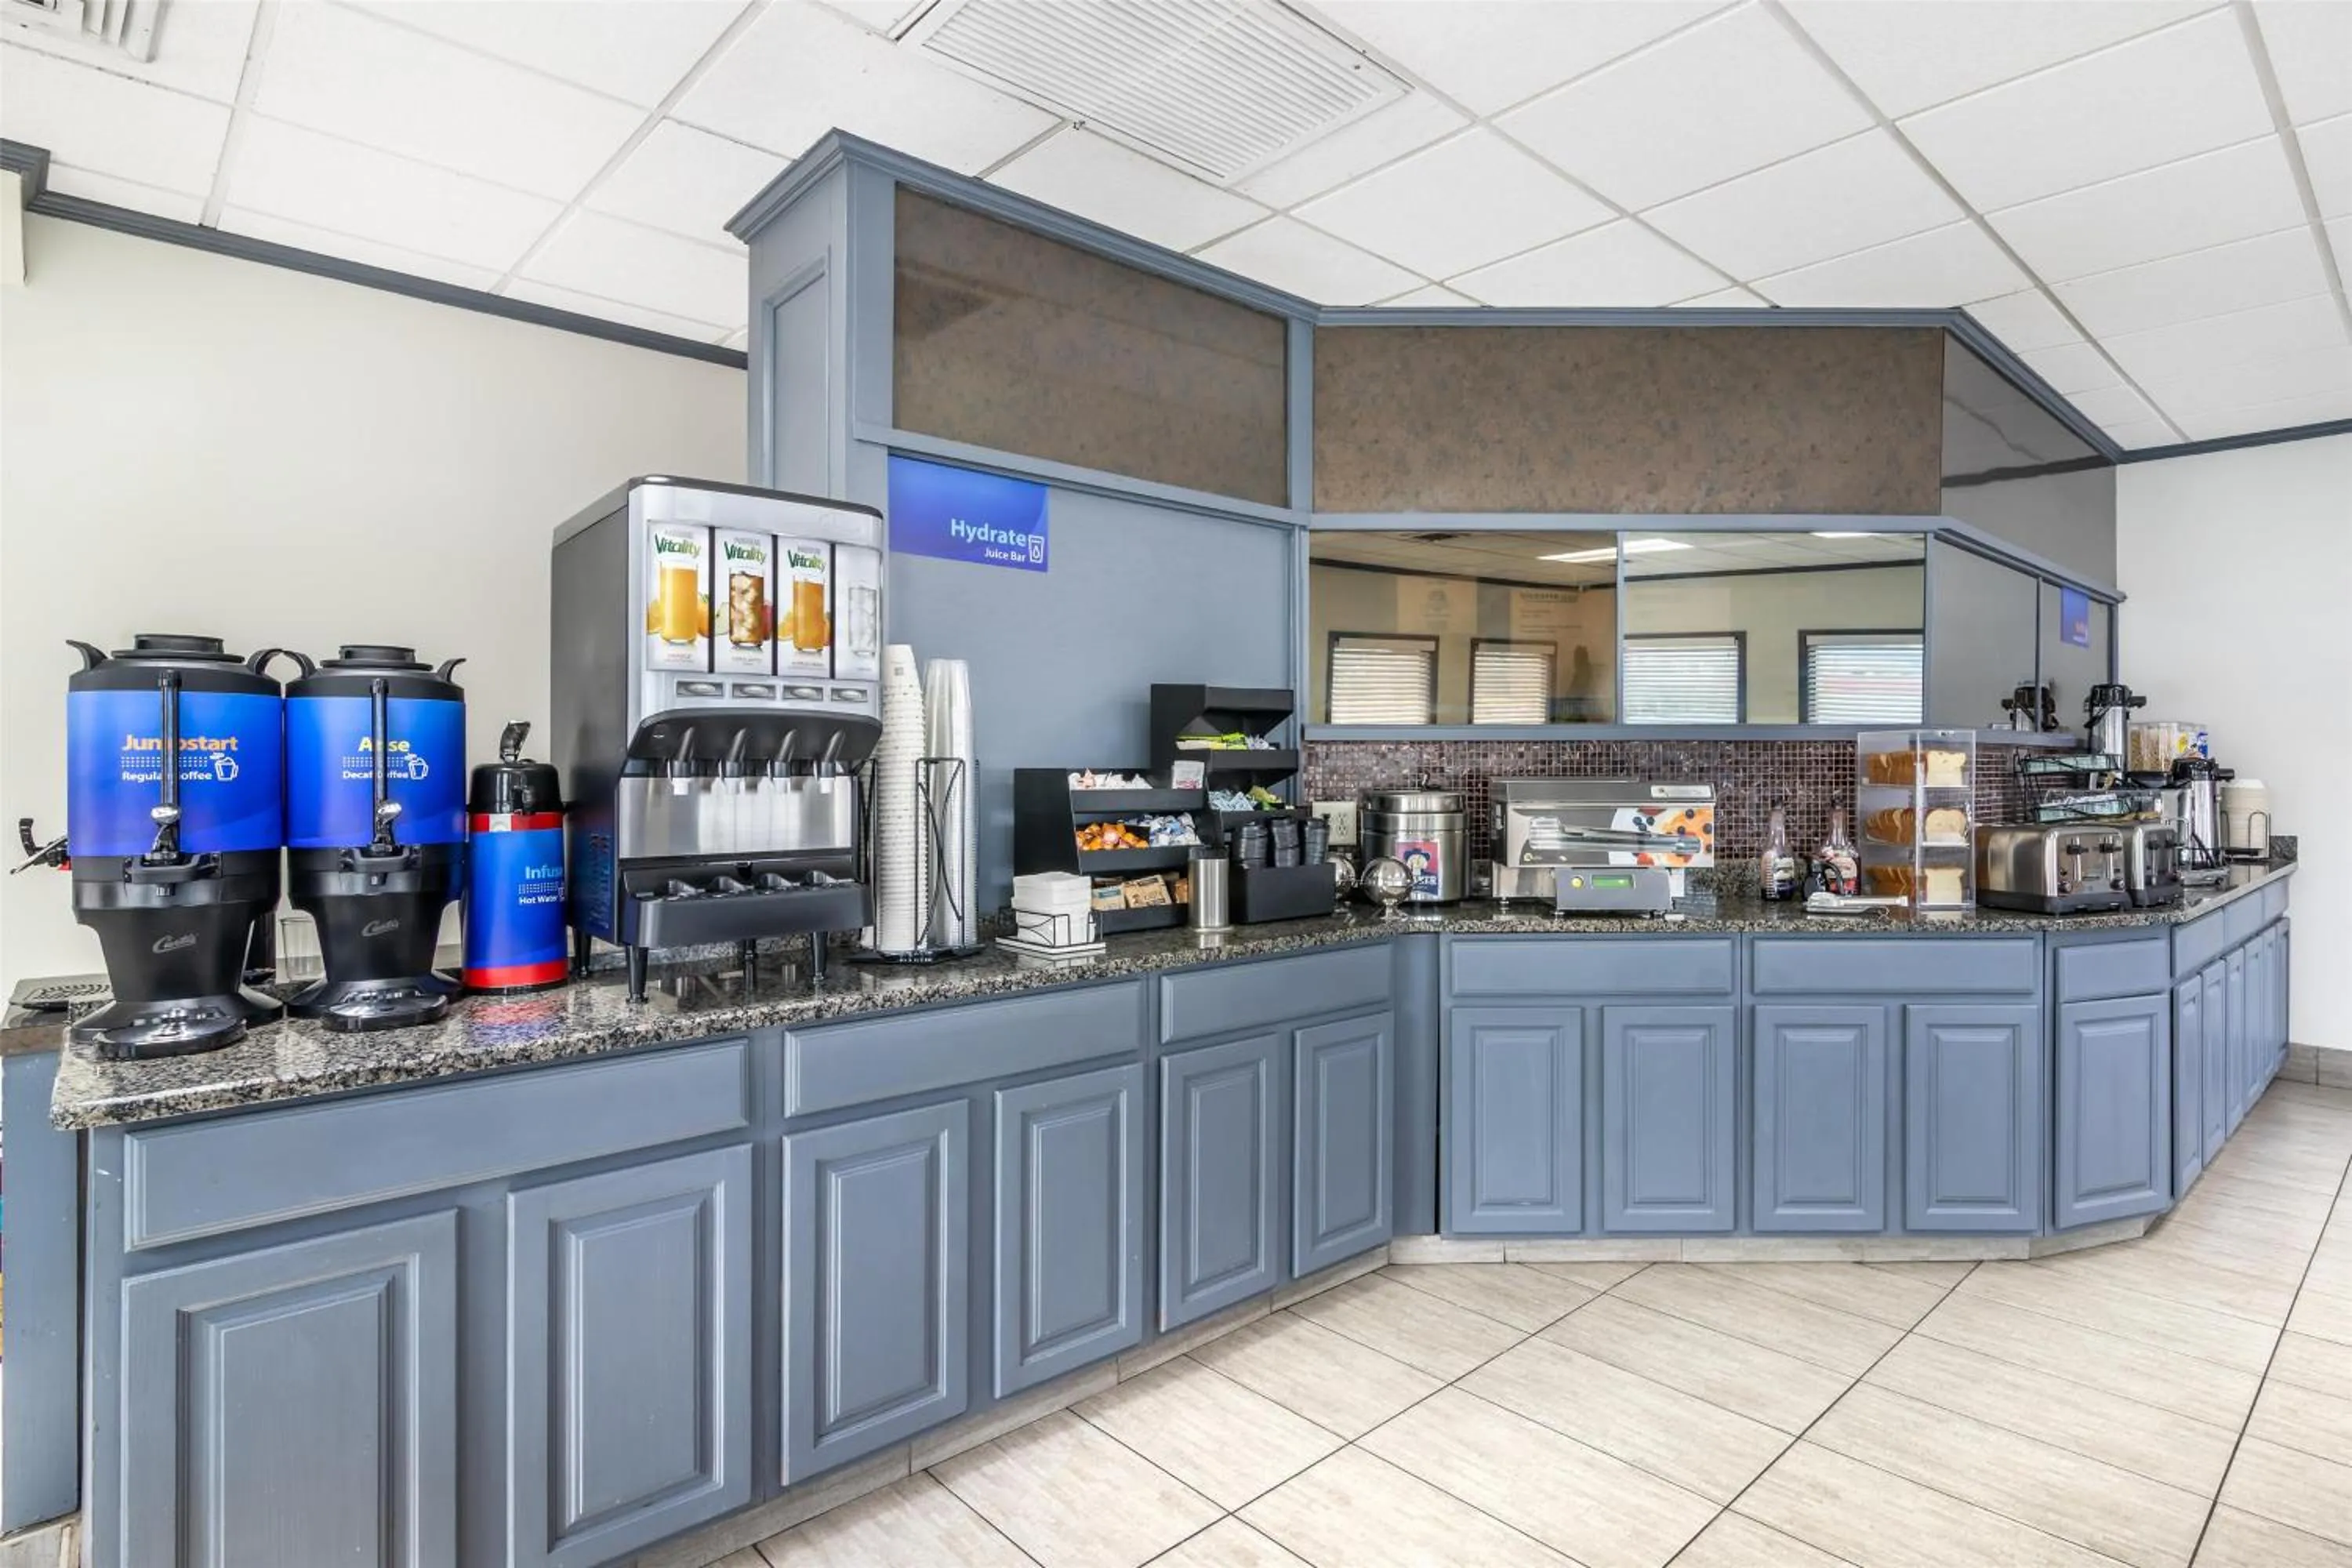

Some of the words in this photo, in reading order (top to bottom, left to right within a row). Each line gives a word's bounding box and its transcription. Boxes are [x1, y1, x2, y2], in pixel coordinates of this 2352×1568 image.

[951, 518, 1027, 547] Hydrate
[655, 532, 701, 559] Vitality
[724, 540, 767, 565] Vitality
[787, 549, 826, 574] Vitality
[984, 547, 1009, 560] Juice
[1010, 551, 1027, 562] Bar
[122, 734, 238, 751] Jumstart
[358, 736, 410, 752] Ase
[122, 771, 168, 782] Regula
[173, 771, 212, 781] offee
[518, 896, 536, 905] Hot
